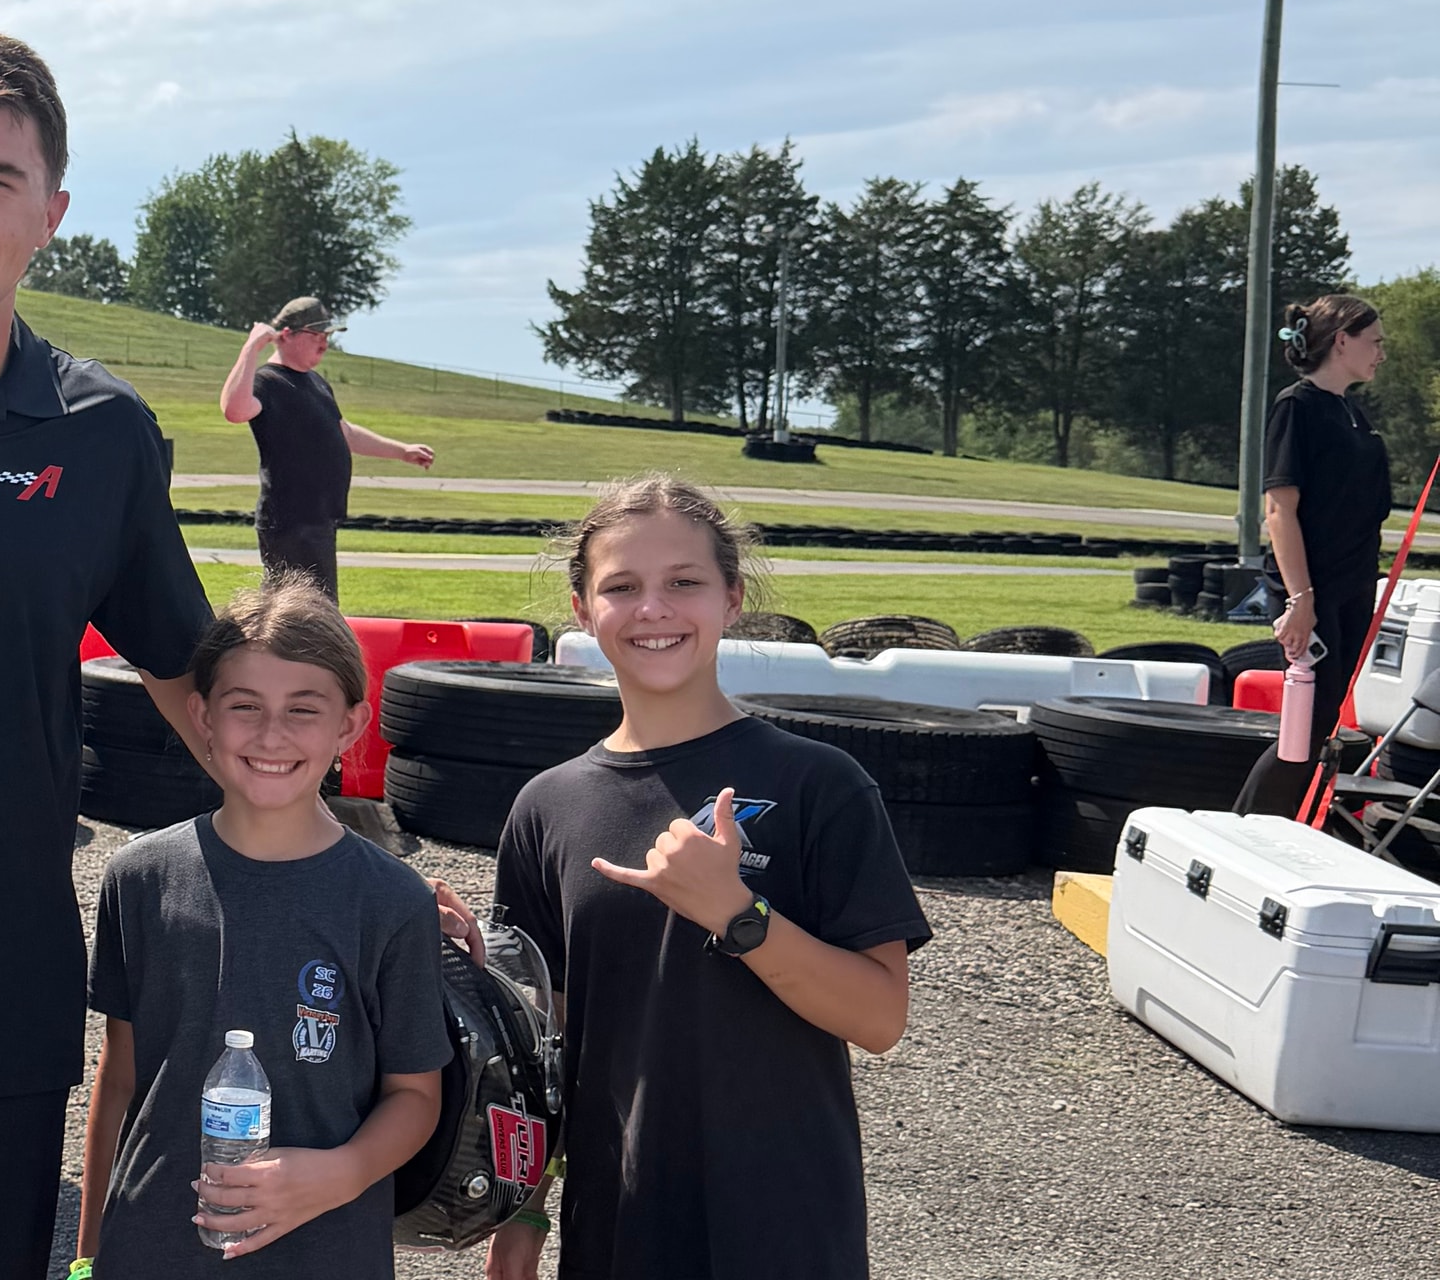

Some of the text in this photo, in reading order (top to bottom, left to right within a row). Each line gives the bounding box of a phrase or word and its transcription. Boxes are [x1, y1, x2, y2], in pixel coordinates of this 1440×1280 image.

[311, 983, 333, 999] 26
[315, 966, 336, 983] SC
[496, 1113, 508, 1176] DRIVERS CLUB
[510, 1091, 529, 1205] TURN
